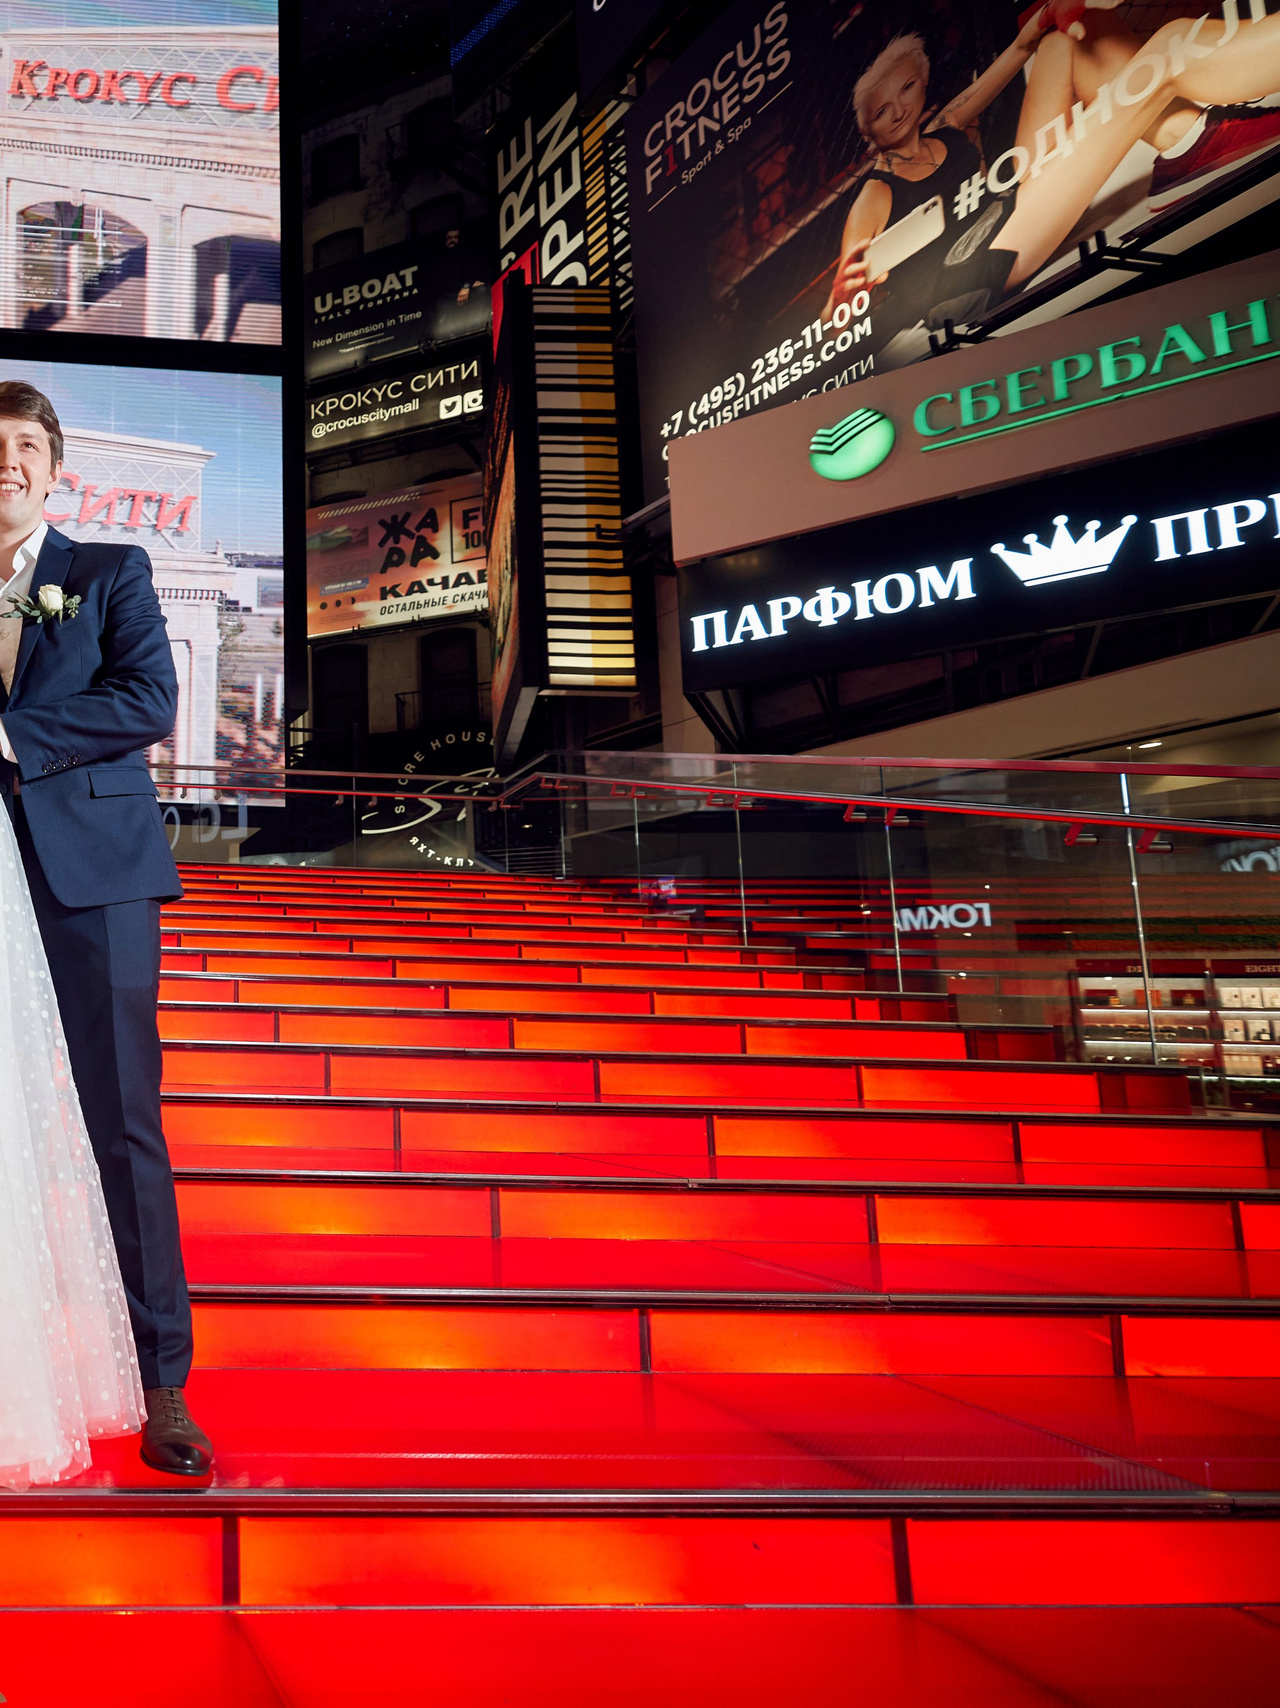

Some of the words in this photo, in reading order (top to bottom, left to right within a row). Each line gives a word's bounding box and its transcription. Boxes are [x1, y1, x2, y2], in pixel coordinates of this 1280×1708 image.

[644, 1, 788, 157] CROCUS
[681, 151, 712, 184] Sport
[715, 139, 725, 155] &
[727, 117, 752, 143] Spa
[314, 265, 418, 314] U-BOAT
[314, 308, 351, 325] ITALO
[359, 288, 418, 310] FONTANA
[312, 336, 333, 349] New
[335, 321, 385, 342] Dimension
[387, 317, 396, 327] in
[398, 310, 422, 324] Time
[310, 381, 403, 420] КРОКУС
[410, 360, 479, 393] СИТИ
[660, 411, 683, 437] +7
[688, 373, 745, 424] (495)
[751, 290, 870, 384] 236-11-00
[913, 293, 1280, 437] СБЕРБАН
[312, 398, 420, 438] @crocuscitymall
[462, 507, 485, 530] F
[690, 557, 976, 653] ПАРФЮМ
[1150, 492, 1280, 563] ПР
[380, 595, 449, 616] ОСТАЛЬНЫЕ
